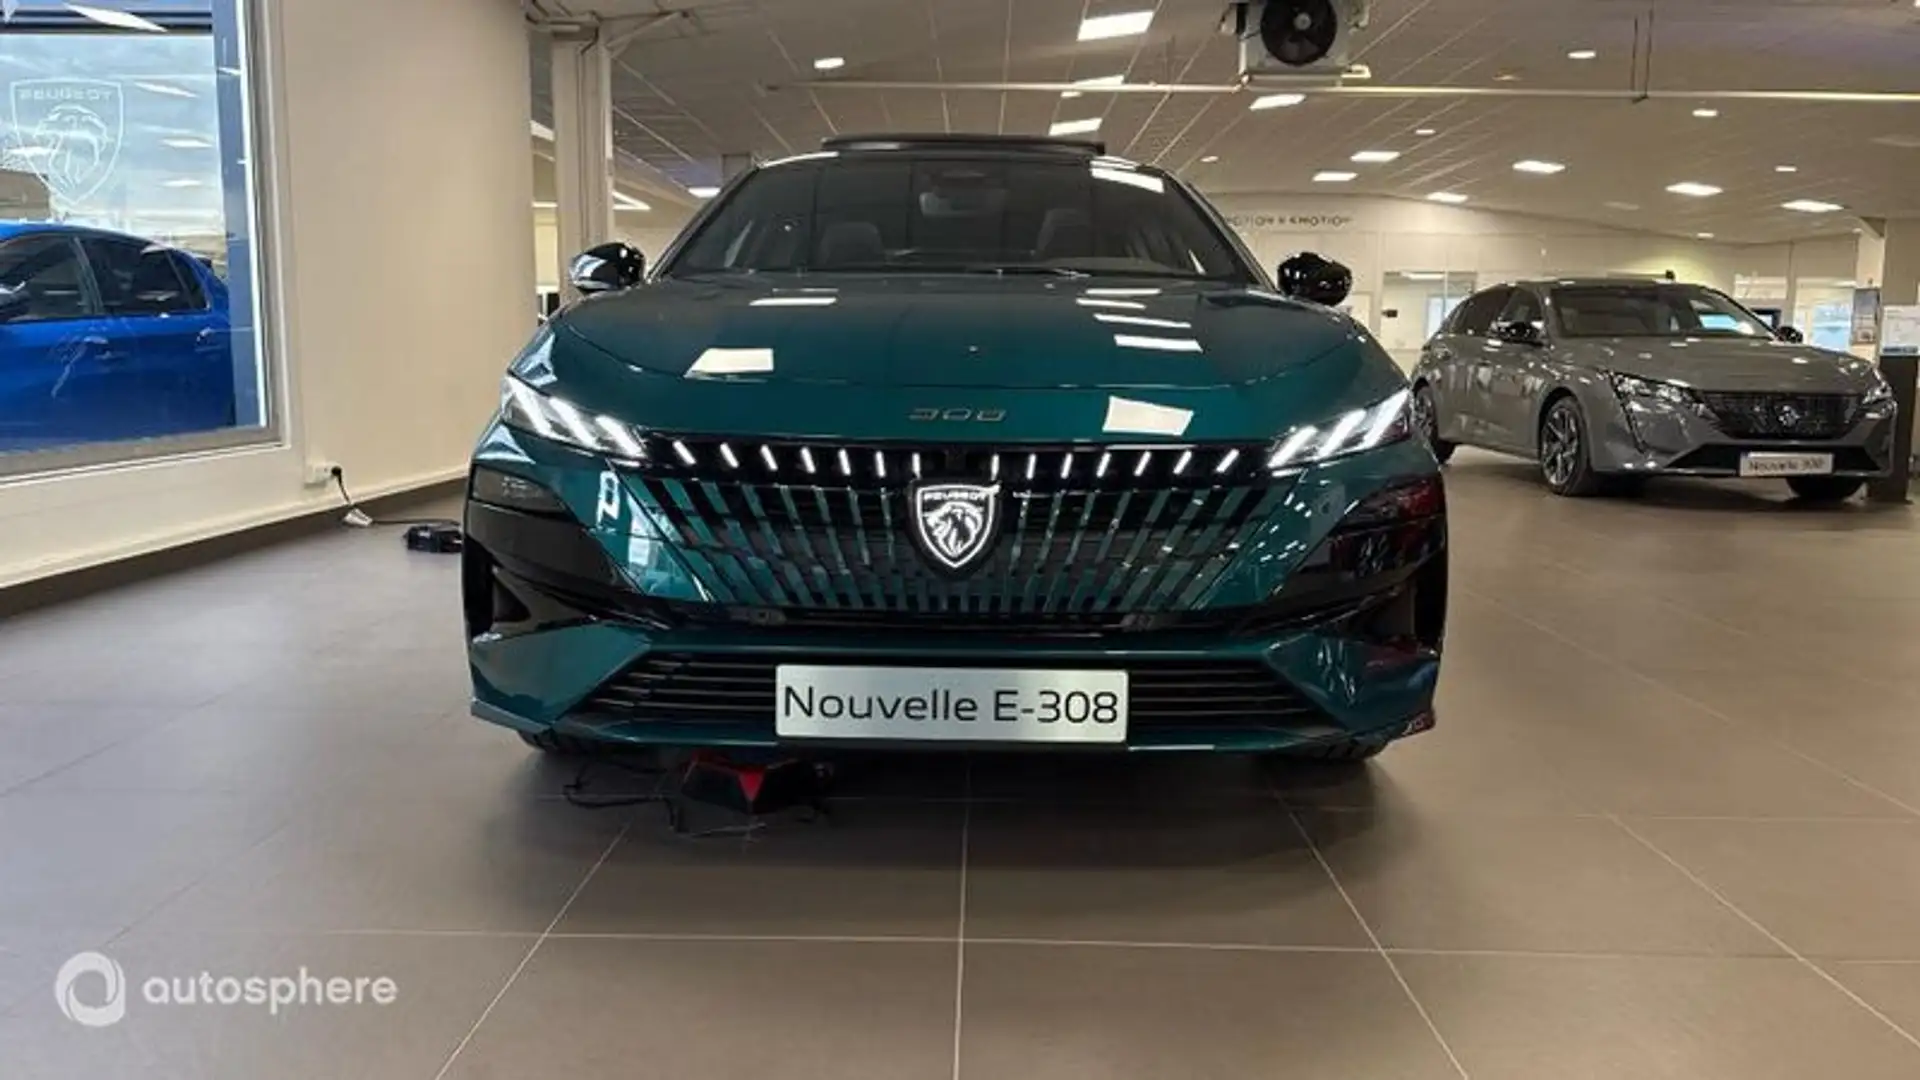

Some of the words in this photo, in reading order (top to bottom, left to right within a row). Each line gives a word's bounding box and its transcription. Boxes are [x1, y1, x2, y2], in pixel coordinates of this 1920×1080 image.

[908, 407, 1006, 422] 308
[783, 685, 979, 722] Nouvelle
[993, 689, 1119, 724] E-308
